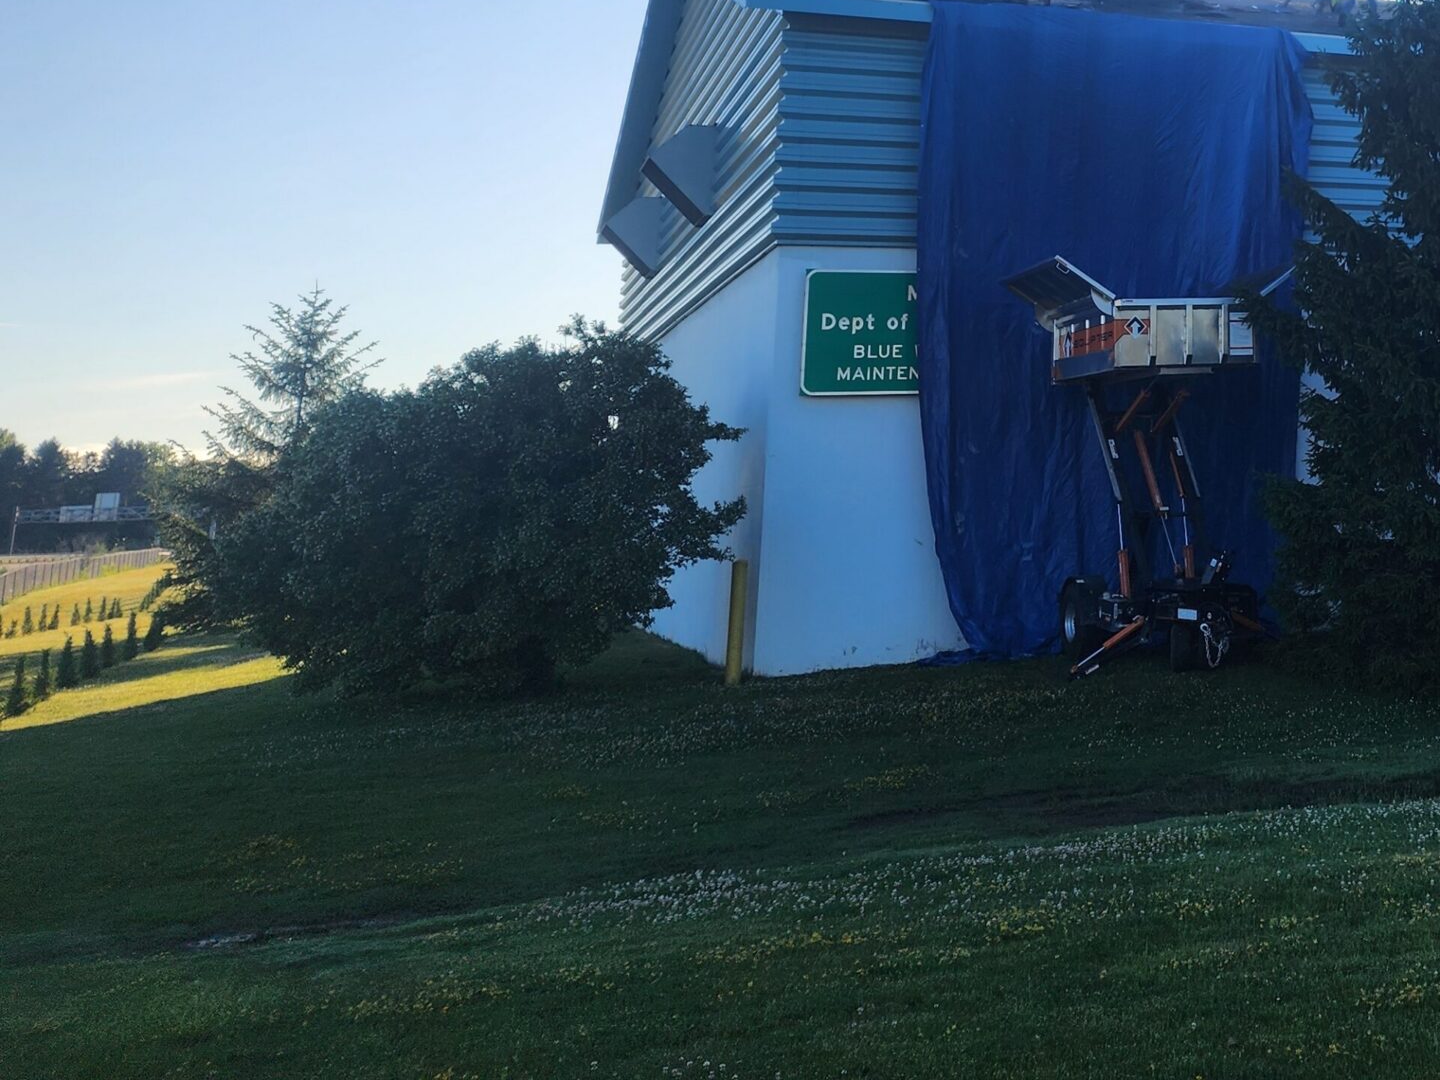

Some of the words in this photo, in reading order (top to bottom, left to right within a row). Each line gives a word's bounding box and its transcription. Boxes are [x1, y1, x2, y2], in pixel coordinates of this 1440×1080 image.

[821, 313, 875, 334] Dept
[886, 313, 909, 330] of
[853, 344, 903, 359] BLUE
[836, 366, 919, 381] MAINTEN
